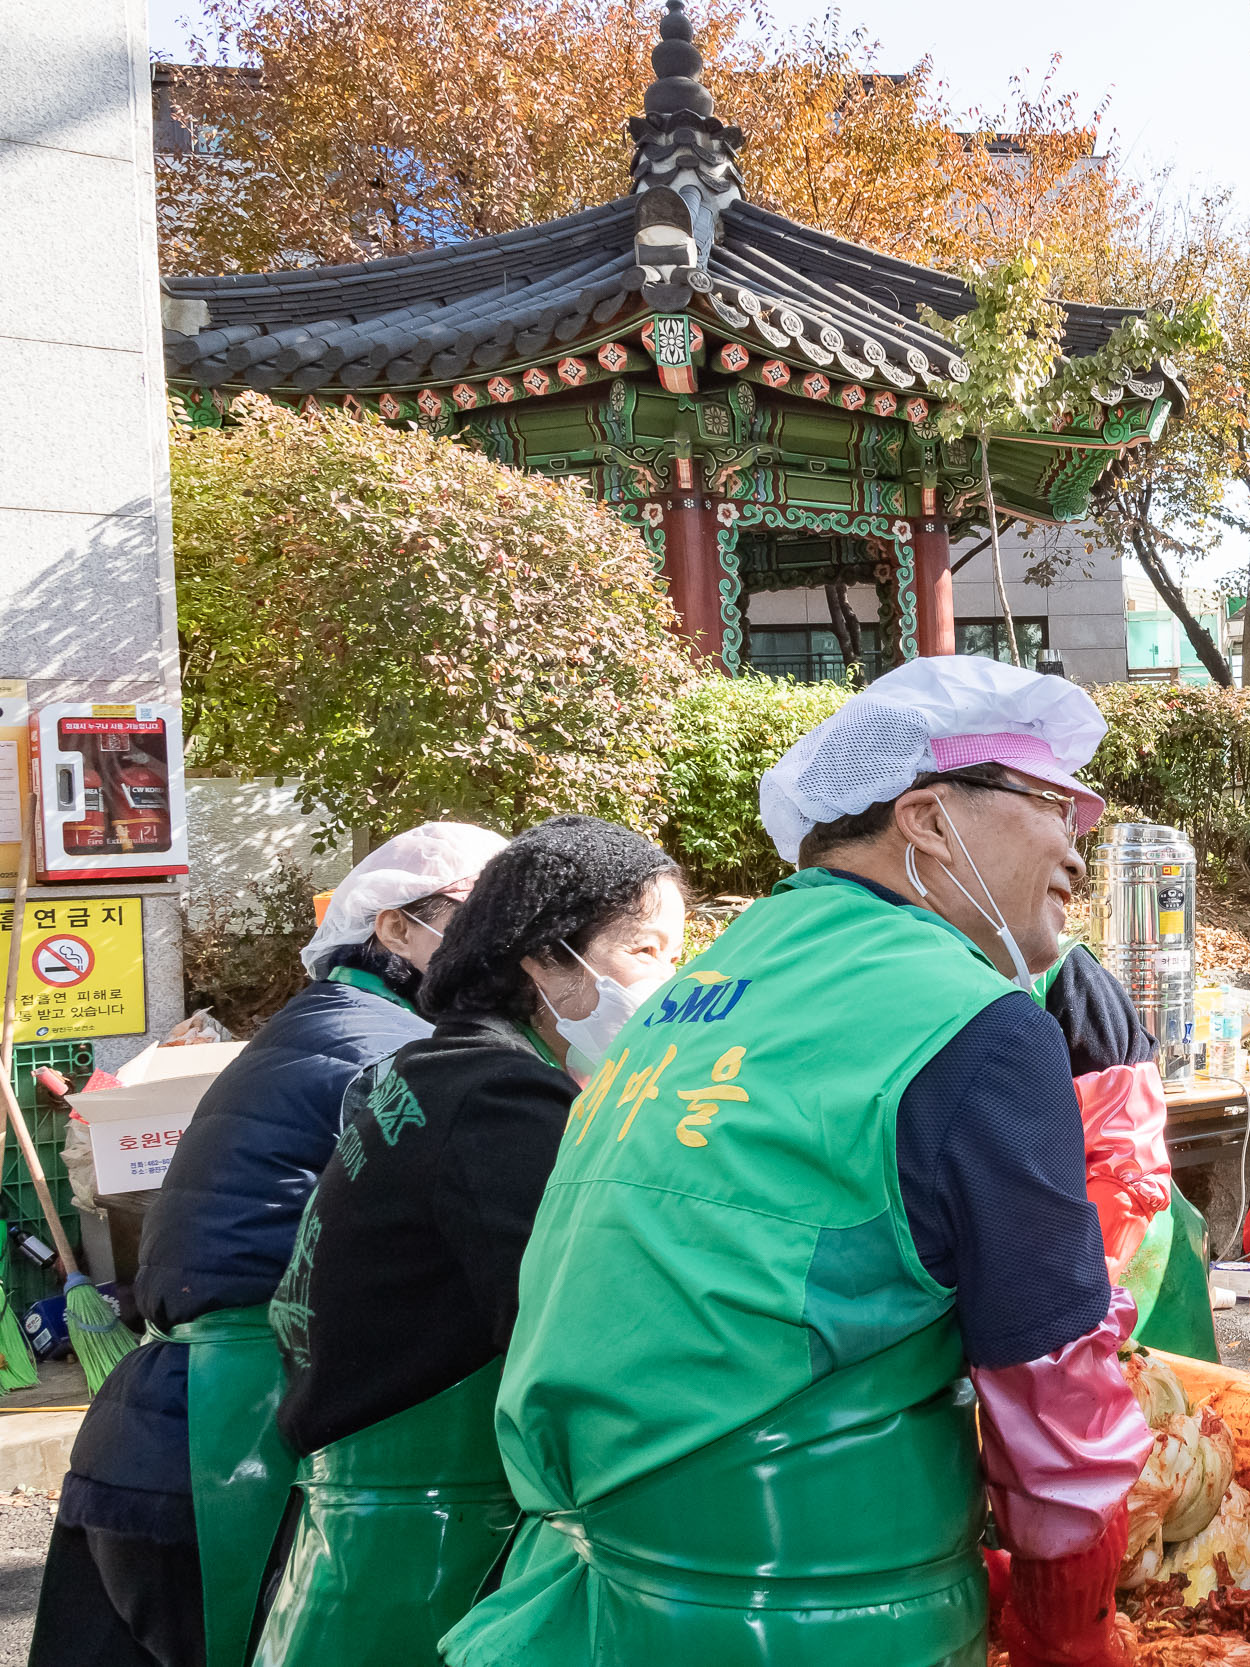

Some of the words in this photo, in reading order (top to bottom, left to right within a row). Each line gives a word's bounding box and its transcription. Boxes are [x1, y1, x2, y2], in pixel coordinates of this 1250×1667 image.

[77, 988, 123, 1002] 피해로
[70, 1003, 125, 1018] 있습니다
[643, 979, 752, 1027] SMU
